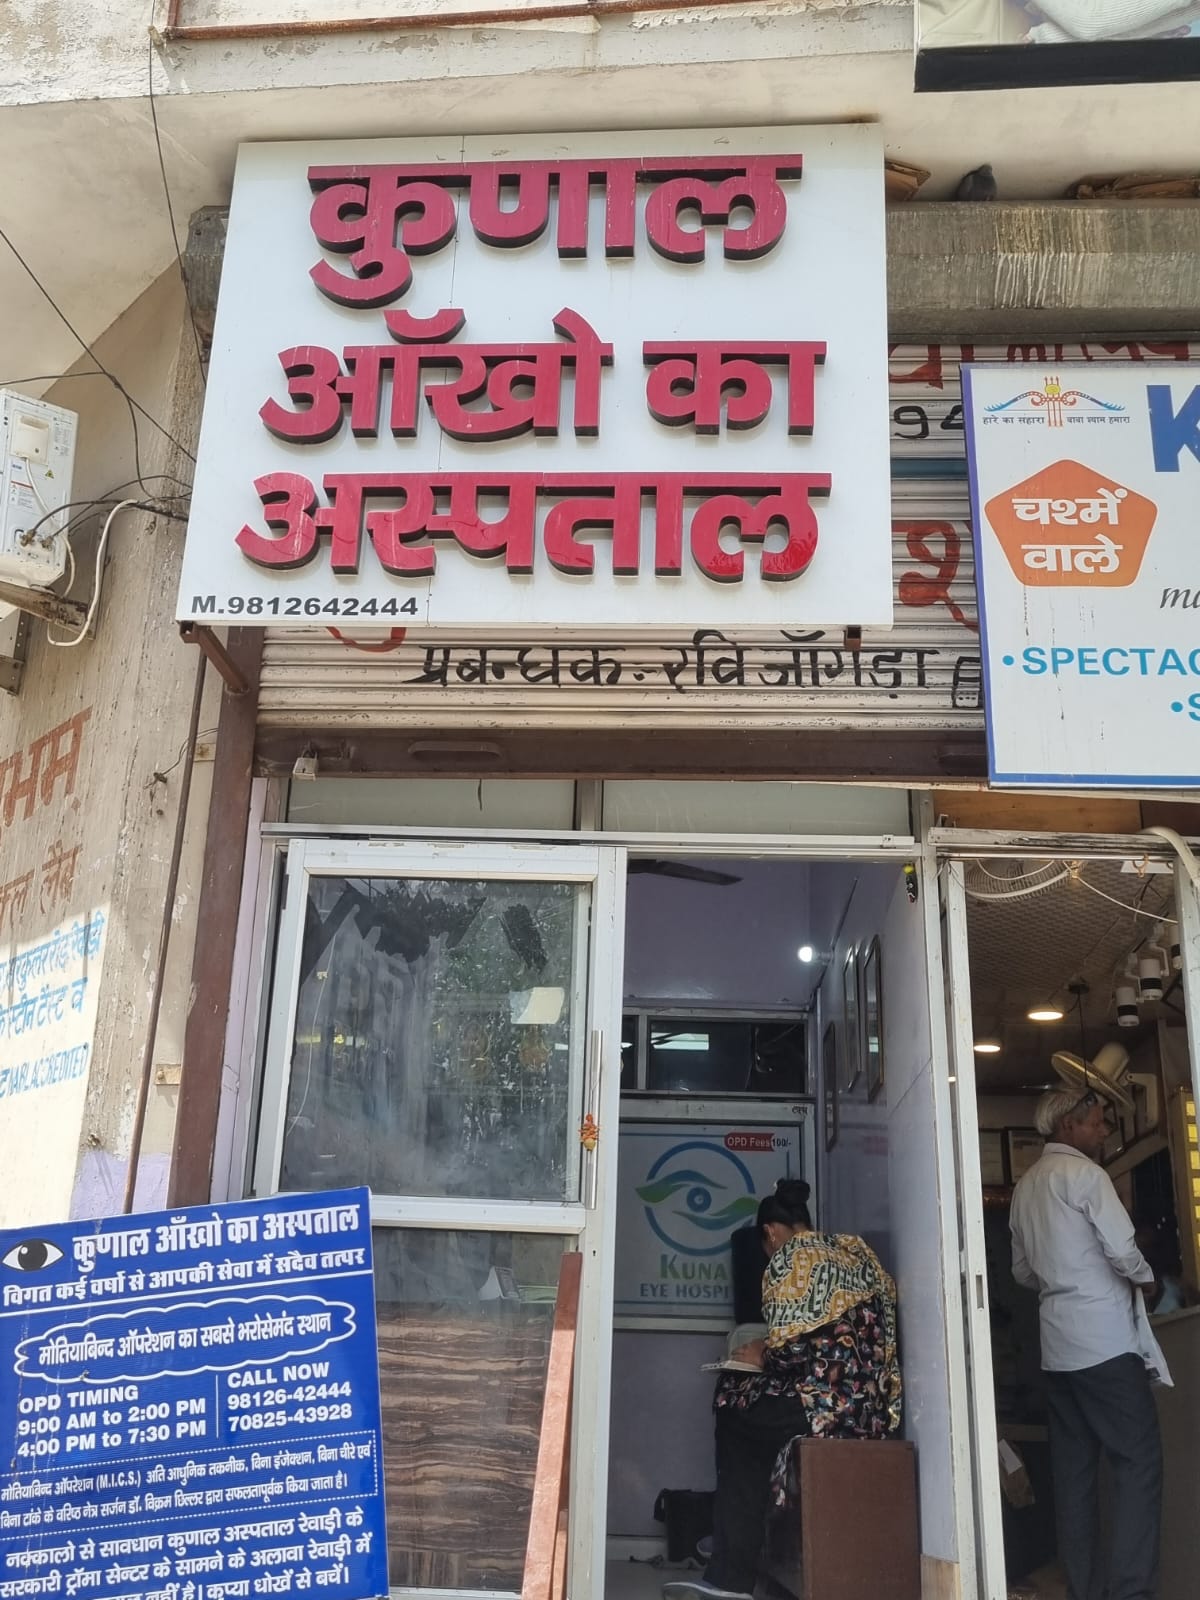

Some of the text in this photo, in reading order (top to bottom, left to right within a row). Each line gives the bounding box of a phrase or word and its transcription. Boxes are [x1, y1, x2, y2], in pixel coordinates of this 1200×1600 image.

[307, 154, 803, 309] कुणाल
[643, 341, 827, 436] का
[1012, 488, 1128, 525] चश्में
[234, 472, 831, 582] अस्पताल
[1021, 533, 1123, 573] वाले
[191, 595, 418, 616] M.9812642444
[727, 1136, 747, 1147] OPD
[749, 1136, 771, 1148] Fees
[72, 1228, 151, 1272] कुणाल
[226, 1216, 259, 1244] का
[262, 1204, 360, 1241] अस्पताल
[3, 1284, 53, 1306] विगत
[56, 1275, 87, 1300] कई
[128, 1269, 145, 1291] से
[149, 1262, 214, 1289] आपकी
[217, 1259, 253, 1280] सेवा
[256, 1253, 274, 1275] में
[275, 1250, 318, 1273] सदैव
[320, 1248, 365, 1268] तत्पर
[640, 1283, 669, 1298] EYE
[38, 1310, 331, 1365] मोतियाबिन्द ऑपरेशन का सबसे भरोसेमंद स्थान
[227, 1362, 330, 1388] CALL NOW
[19, 1385, 139, 1413] OPD TIMING
[227, 1381, 352, 1410] 98126-42444
[18, 1398, 206, 1435] 9:00 AM to 2:00 PM
[228, 1403, 353, 1432] 70825-43928
[17, 1420, 206, 1457] 4:00 PM to 7:30 PM
[96, 1470, 141, 1493] (M.I.C.S.)
[147, 1464, 166, 1484] अति
[167, 1460, 206, 1486] आधुनिक
[251, 1453, 272, 1471] बिना
[317, 1444, 338, 1463] बिना
[339, 1442, 356, 1460] चीरे
[43, 1505, 55, 1523] के
[101, 1497, 126, 1516] सर्जन
[145, 1492, 172, 1512] विक्रम
[286, 1475, 309, 1494] किया
[310, 1473, 333, 1490] जाता
[79, 1538, 95, 1560] से
[99, 1534, 164, 1557] सावधान
[167, 1527, 221, 1556] कुणाल
[224, 1518, 295, 1542] अस्पताल
[298, 1508, 342, 1534] रेवाड़ी
[345, 1506, 364, 1527] के
[0, 1532, 373, 1598] सरकारी ट्रॉमा सेन्टर के सामने के अलावा रेवाड़ी में
[296, 1567, 312, 1589] से
